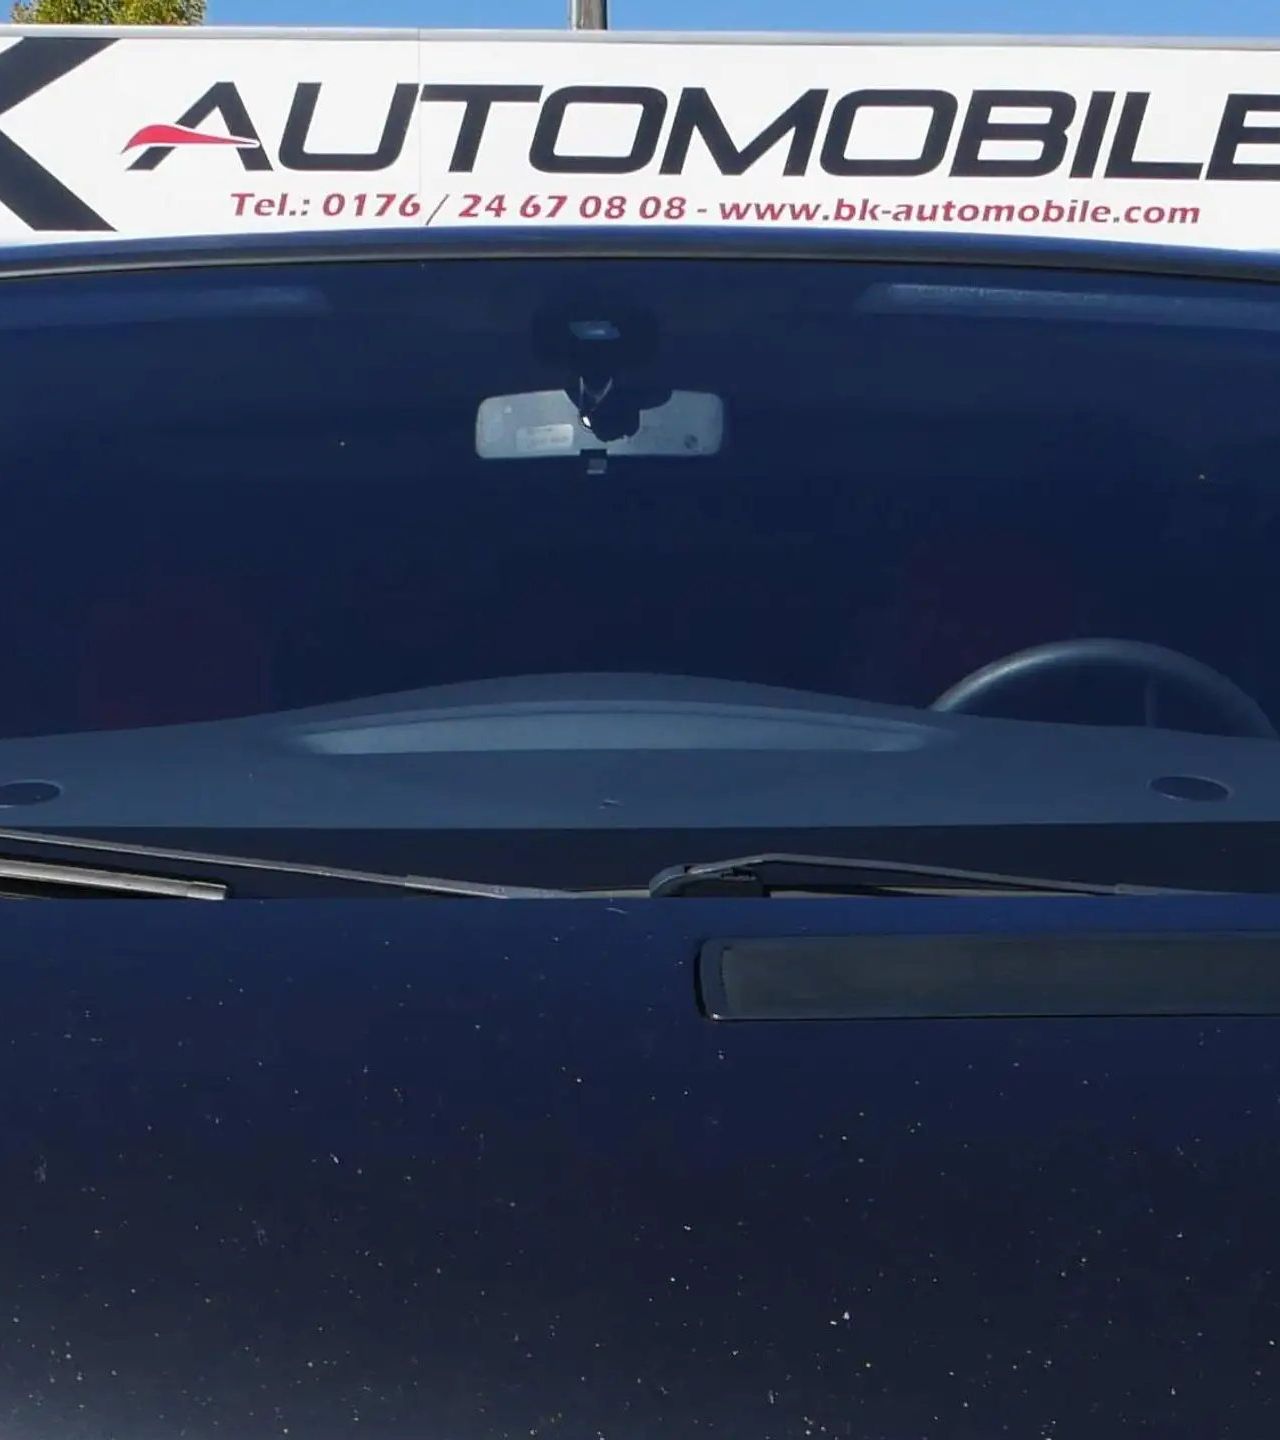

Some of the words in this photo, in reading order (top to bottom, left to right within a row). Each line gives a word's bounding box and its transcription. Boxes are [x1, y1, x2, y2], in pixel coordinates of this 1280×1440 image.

[230, 193, 310, 216] Tel.:
[322, 193, 421, 217] 0176
[458, 194, 507, 218] 24
[519, 195, 568, 218] 67
[579, 196, 626, 219] 08
[638, 196, 686, 220] 08
[719, 198, 1201, 224] www.bk-automobile.com
